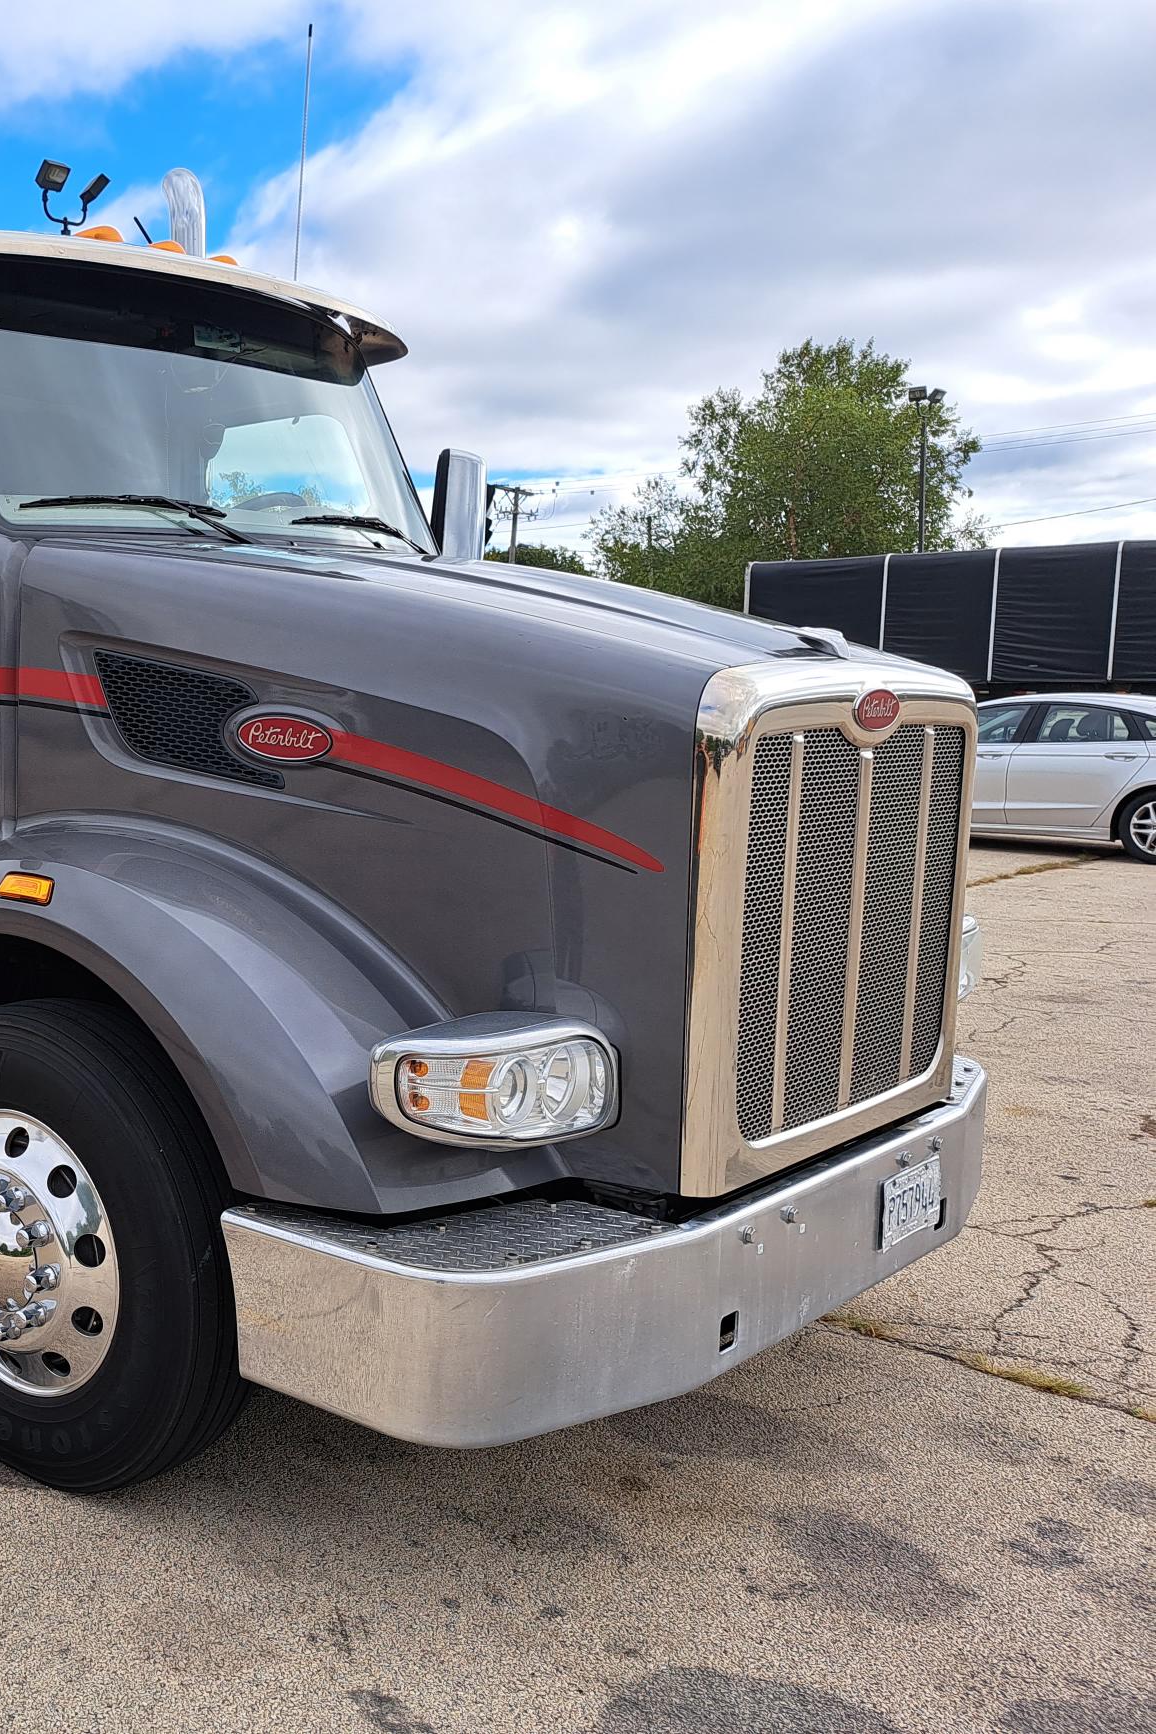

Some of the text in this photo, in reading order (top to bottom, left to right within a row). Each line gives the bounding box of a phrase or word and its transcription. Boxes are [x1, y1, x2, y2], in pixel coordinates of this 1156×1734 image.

[862, 696, 897, 720] Peterbilt
[248, 722, 322, 749] Peterbilt
[888, 1180, 934, 1233] P757944
